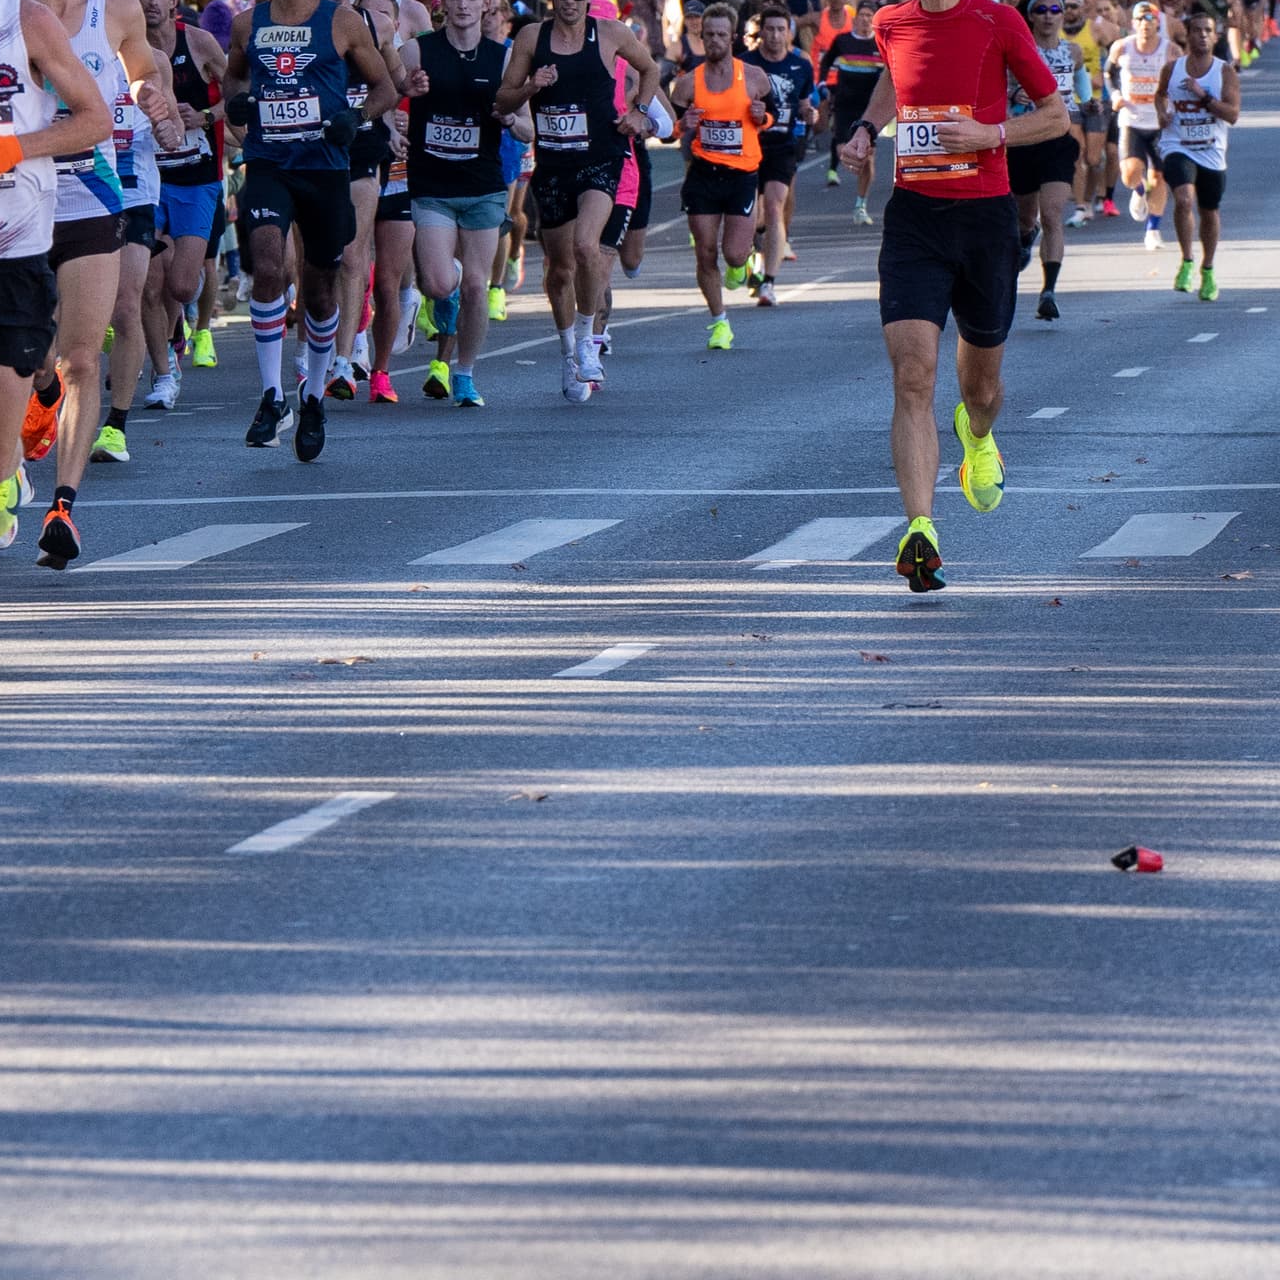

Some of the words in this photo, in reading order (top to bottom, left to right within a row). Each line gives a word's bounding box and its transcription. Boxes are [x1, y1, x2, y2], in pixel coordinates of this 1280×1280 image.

[260, 30, 308, 43] CANDEAL
[280, 57, 292, 69] P
[267, 100, 309, 120] 1458
[903, 108, 918, 120] tcs
[545, 115, 577, 131] 1507
[433, 126, 472, 143] 3820
[706, 129, 735, 142] 1593
[906, 124, 941, 148] 195
[1186, 125, 1210, 137] 1588
[950, 163, 969, 171] 2024
